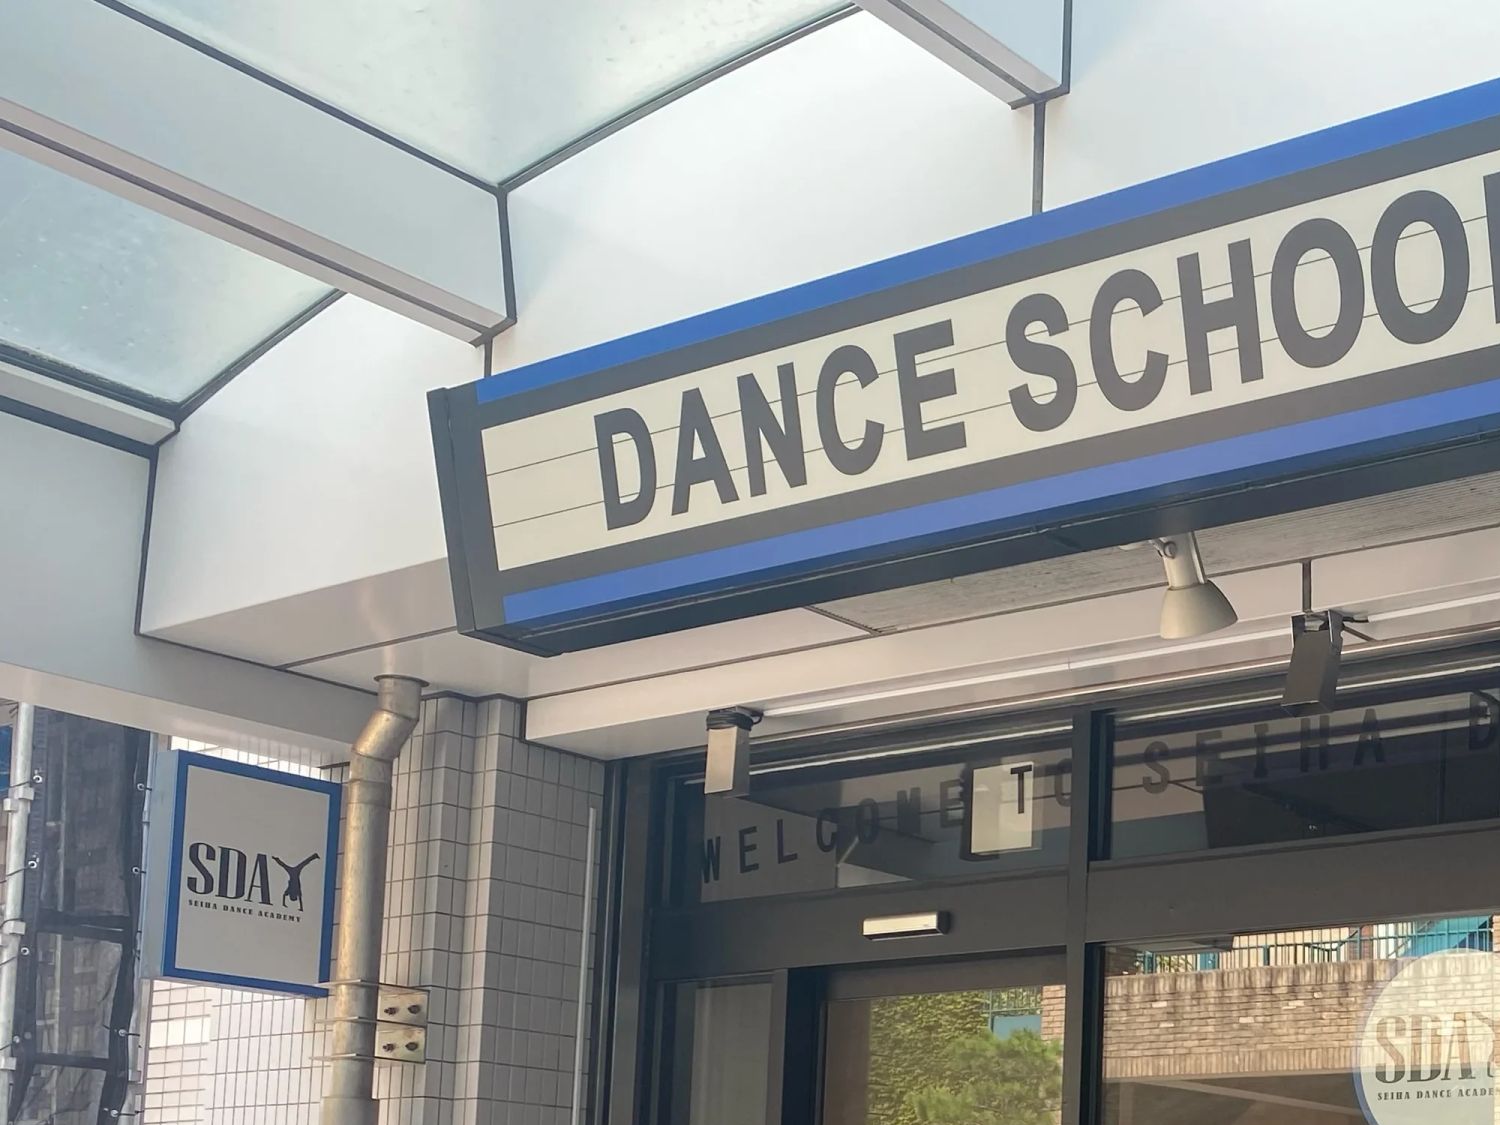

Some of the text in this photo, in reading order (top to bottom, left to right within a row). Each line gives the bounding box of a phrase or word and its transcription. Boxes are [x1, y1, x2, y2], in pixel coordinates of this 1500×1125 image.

[594, 318, 966, 531] DANCE
[701, 778, 968, 886] WELCOME
[1141, 707, 1387, 795] SEIHA
[222, 904, 254, 916] DANCE
[257, 910, 303, 923] ACADEMY
[1377, 1091, 1410, 1101] SEIHA
[1416, 1089, 1452, 1099] DANCE
